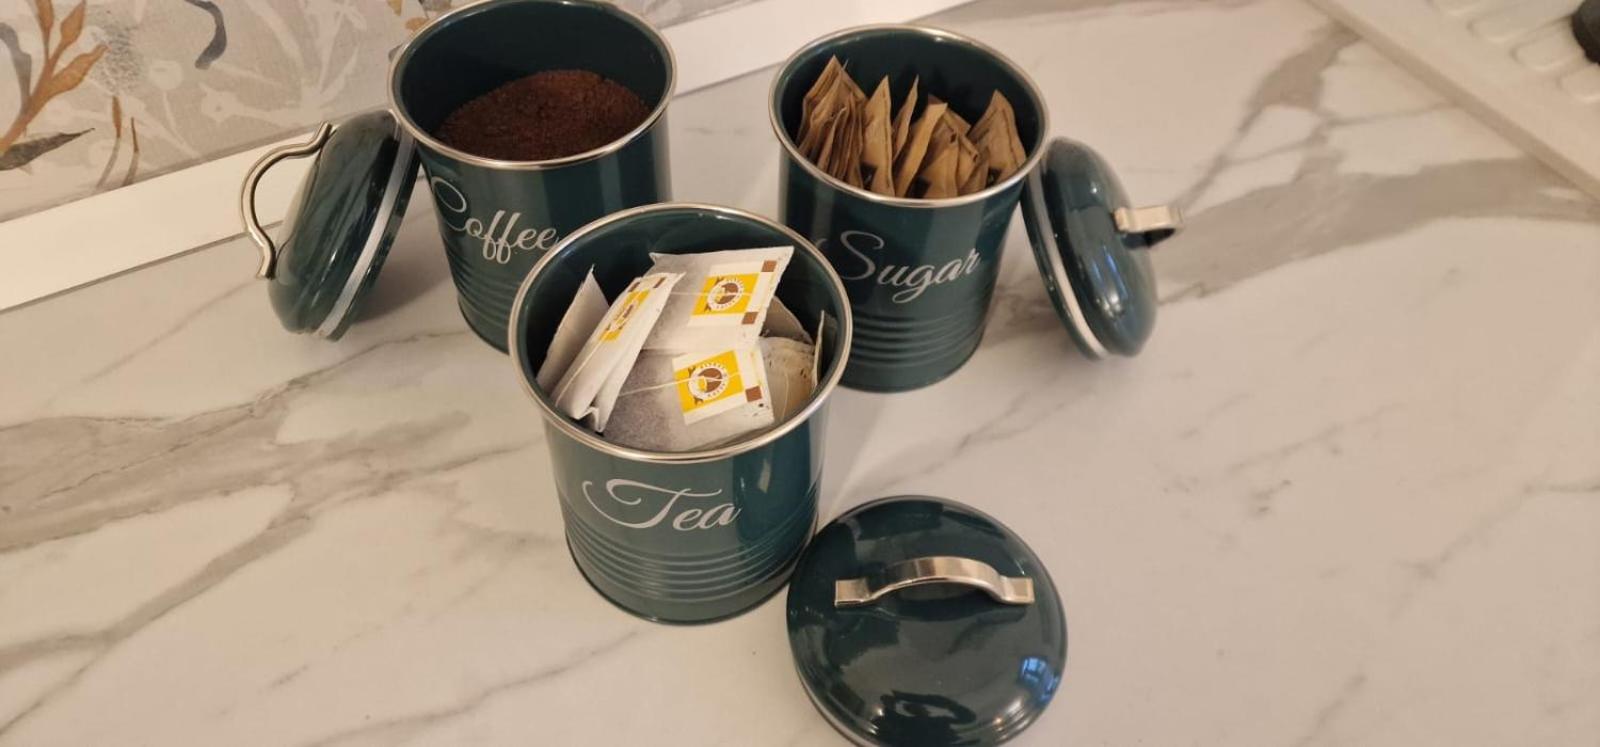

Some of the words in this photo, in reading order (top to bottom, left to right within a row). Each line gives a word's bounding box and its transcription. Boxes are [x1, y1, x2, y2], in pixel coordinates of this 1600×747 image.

[431, 176, 560, 264] Coffee
[816, 230, 981, 304] Sugar
[582, 478, 742, 531] Tea
